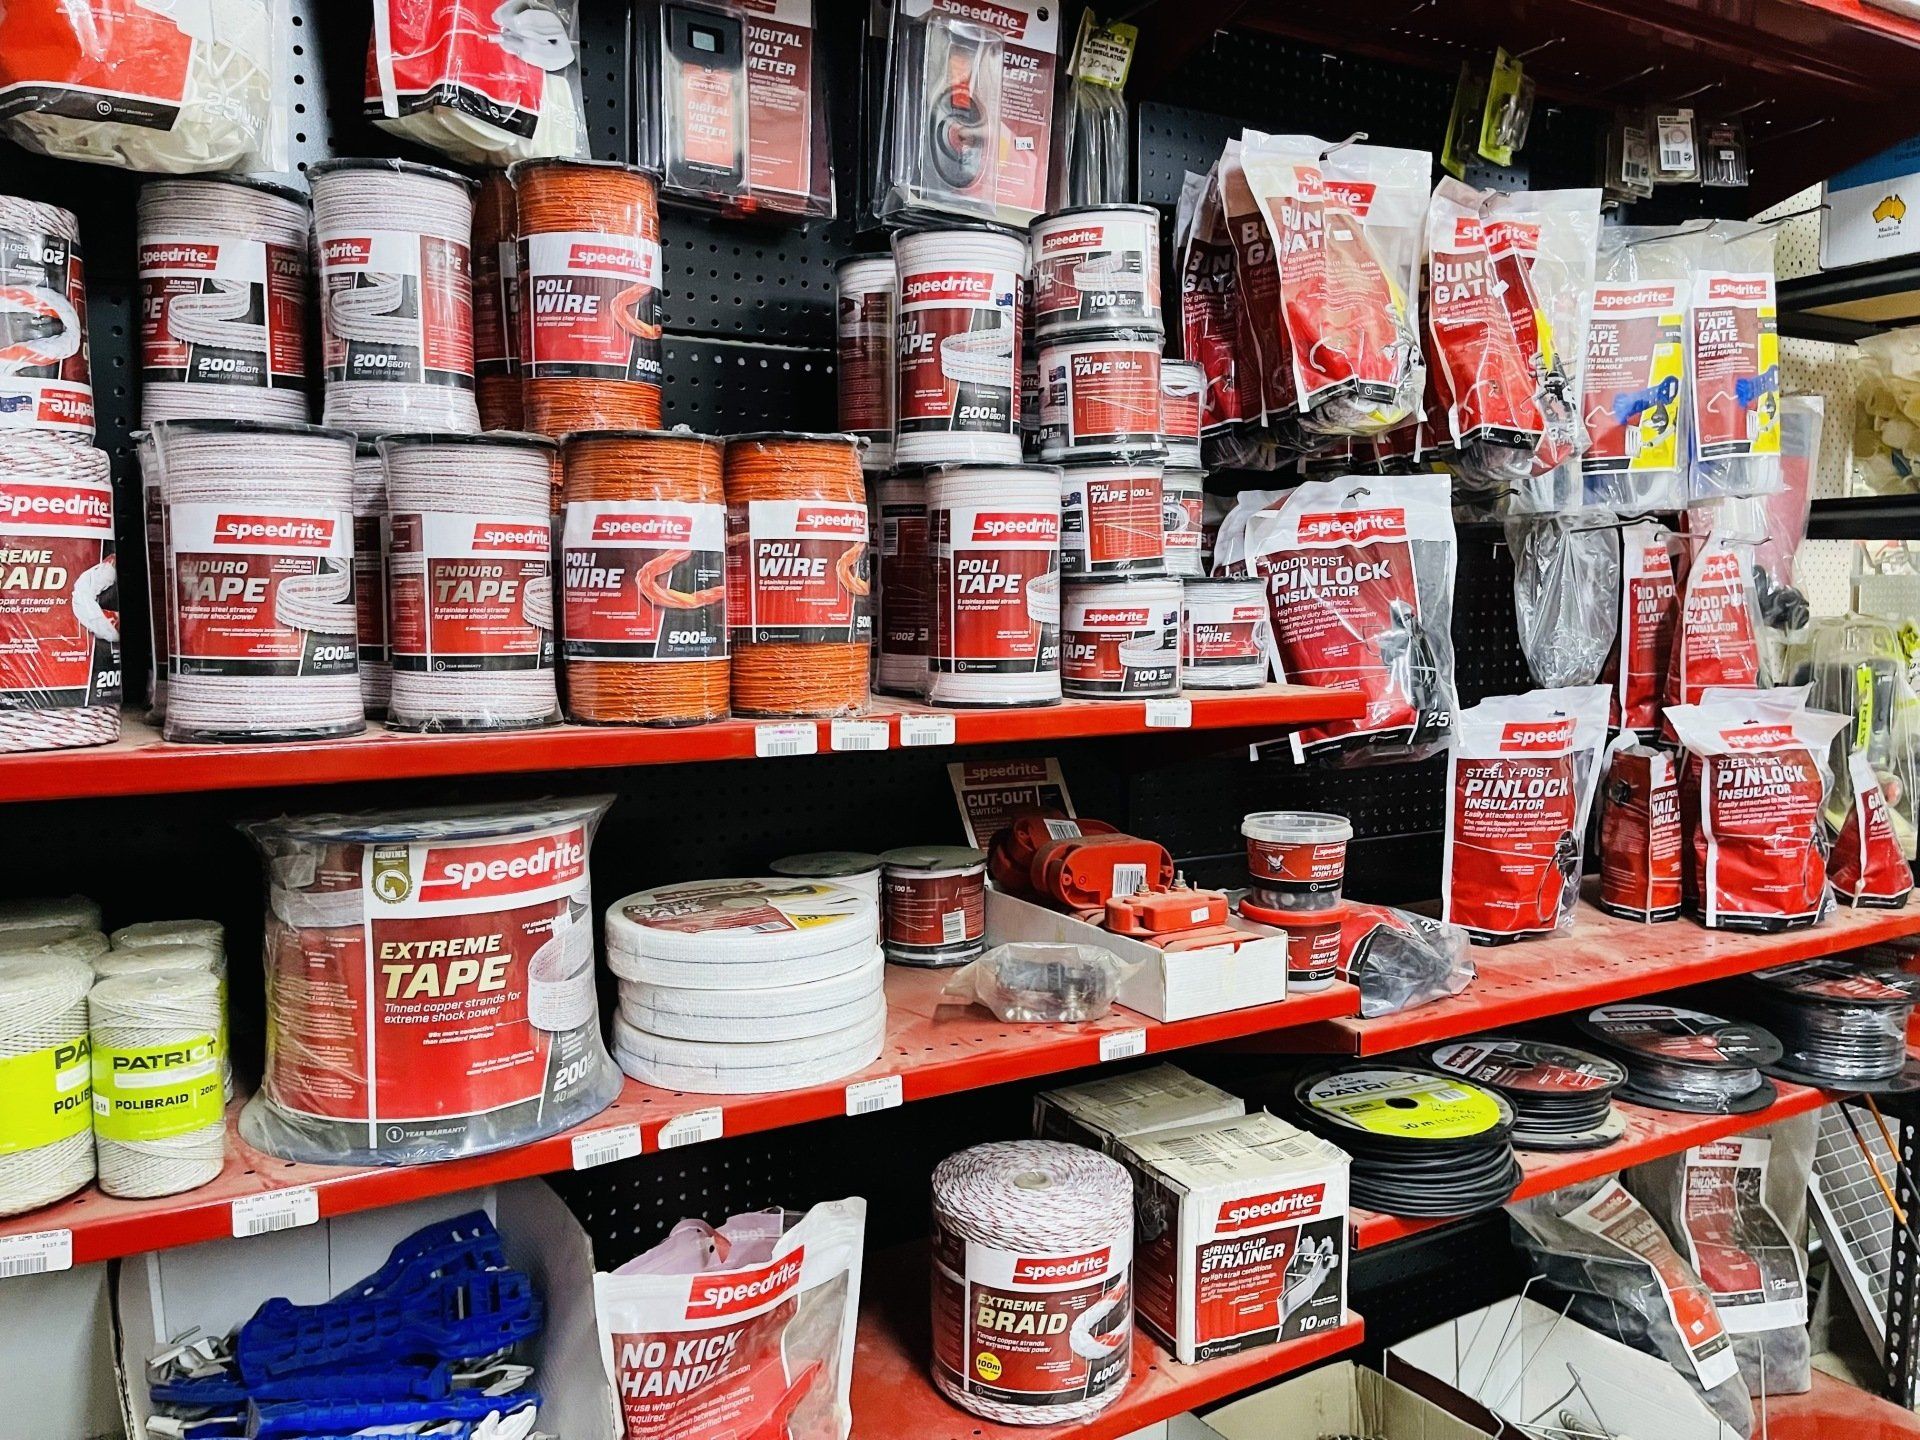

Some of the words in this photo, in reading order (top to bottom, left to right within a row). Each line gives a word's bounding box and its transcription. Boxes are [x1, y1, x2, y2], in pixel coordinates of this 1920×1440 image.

[942, 0, 1019, 30] speedrite
[1003, 52, 1040, 70] ENCE
[688, 101, 730, 117] DIGITAL
[689, 112, 716, 124] VOLT
[688, 122, 727, 138] METER
[1045, 233, 1098, 248] speedrite
[143, 247, 208, 264] speedrite
[579, 250, 647, 270] speedrite
[536, 280, 572, 293] POLI
[907, 276, 985, 296] speedrite
[1714, 283, 1762, 294] speedrite
[537, 295, 600, 313] WIRE
[1089, 295, 1117, 307] 100
[1601, 291, 1667, 308] speedrite
[1699, 316, 1736, 329] TAPE
[1699, 329, 1738, 344] GATE
[199, 358, 235, 373] 200
[354, 354, 387, 367] 200
[637, 357, 656, 370] 500
[1074, 356, 1092, 364] POLI
[1615, 355, 1648, 363] PURPOSE
[1074, 362, 1112, 376] TAPE
[1114, 362, 1130, 370] 100
[959, 407, 989, 419] 200
[1091, 490, 1127, 503] TAPE
[0, 494, 109, 517] speedrite
[227, 523, 323, 539] speedrite
[602, 520, 683, 535] speedrite
[984, 518, 1057, 536] speedrite
[1308, 516, 1394, 538] speedrite
[759, 544, 800, 556] POLI
[182, 561, 248, 574] ENDURO
[566, 553, 596, 566] POLI
[760, 559, 827, 576] WIRE
[958, 560, 999, 573] POLI
[1268, 558, 1308, 573] WOOD
[1312, 555, 1344, 566] POST
[435, 566, 503, 577] ENDURO
[567, 569, 625, 588] WIRE
[1271, 560, 1392, 594] PINLOCK
[183, 578, 270, 603] TAPE
[436, 580, 519, 603] TAPE
[959, 575, 1022, 594] TAPE
[1276, 585, 1359, 608] INSULATOR
[1089, 613, 1143, 624] speedrite
[1277, 608, 1293, 617] High
[1289, 614, 1306, 623] heavy
[1307, 611, 1321, 619] duty
[1197, 625, 1218, 633] POLI
[1293, 620, 1314, 628] Pinlock
[1299, 627, 1313, 635] easy
[669, 632, 699, 644] 500
[1197, 632, 1232, 643] WIRE
[313, 647, 343, 661] 200
[1063, 645, 1097, 659] TAPE
[97, 671, 121, 687] 200
[1134, 670, 1157, 681] 100
[1426, 712, 1449, 728] 25
[1728, 731, 1788, 747] speedrite
[1717, 758, 1748, 769] STEEL
[973, 764, 1039, 780] speedrite
[1466, 768, 1504, 778] STEEL
[1509, 768, 1552, 777] Y-POST
[1717, 765, 1807, 788] PINLOCK
[1465, 777, 1569, 798] PINLOCK
[1719, 784, 1791, 800] INSULATOR
[967, 790, 1032, 807] CUT-OUT
[1465, 799, 1544, 810] INSULATOR
[970, 808, 1002, 816] SWITCH
[1464, 811, 1484, 819] Easily
[375, 850, 407, 859] EQUINE
[445, 843, 584, 889] speedrite
[380, 934, 503, 960] EXTREME
[381, 954, 512, 999] TAPE
[384, 1003, 422, 1014] Tinned
[423, 1000, 462, 1014] copper
[464, 996, 505, 1009] strands
[507, 991, 521, 1002] for
[384, 1013, 429, 1024] extreme
[431, 1010, 466, 1021] shock
[467, 1007, 501, 1021] power
[113, 1038, 216, 1070] PATRIOT
[553, 1061, 586, 1092] 200
[1315, 1076, 1419, 1098] PATRIOT
[116, 1093, 189, 1110] POLIBRAID
[201, 1084, 218, 1096] 200m
[553, 1090, 567, 1103] 40
[406, 1130, 424, 1138] YEAR
[426, 1126, 467, 1137] WARRANTY
[1229, 1193, 1314, 1225] speedrite
[1203, 1243, 1240, 1260] SPRING
[1242, 1237, 1267, 1251] CLIP
[1201, 1242, 1286, 1273] STRAINER
[1024, 1256, 1104, 1280] speedrite
[1224, 1270, 1240, 1279] strain
[1241, 1264, 1272, 1276] conditions
[704, 1262, 799, 1309] speedrite
[1770, 1279, 1786, 1290] 125
[978, 1294, 1046, 1312] EXTREME
[977, 1307, 1068, 1335] BRAID
[1300, 1315, 1317, 1332] 10
[1317, 1316, 1338, 1327] UNITS
[977, 1331, 995, 1341] Tinned
[996, 1336, 1019, 1347] copper
[986, 1340, 1011, 1351] extreme
[1011, 1345, 1030, 1353] shock
[1031, 1346, 1052, 1354] power
[621, 1340, 667, 1369] NO
[673, 1327, 745, 1367] KICK
[978, 1359, 1001, 1370] 100m
[1094, 1361, 1115, 1384] 400
[621, 1349, 737, 1398] HANDLE
[634, 1404, 650, 1412] use
[652, 1401, 675, 1411] when
[629, 1415, 665, 1424] required.
